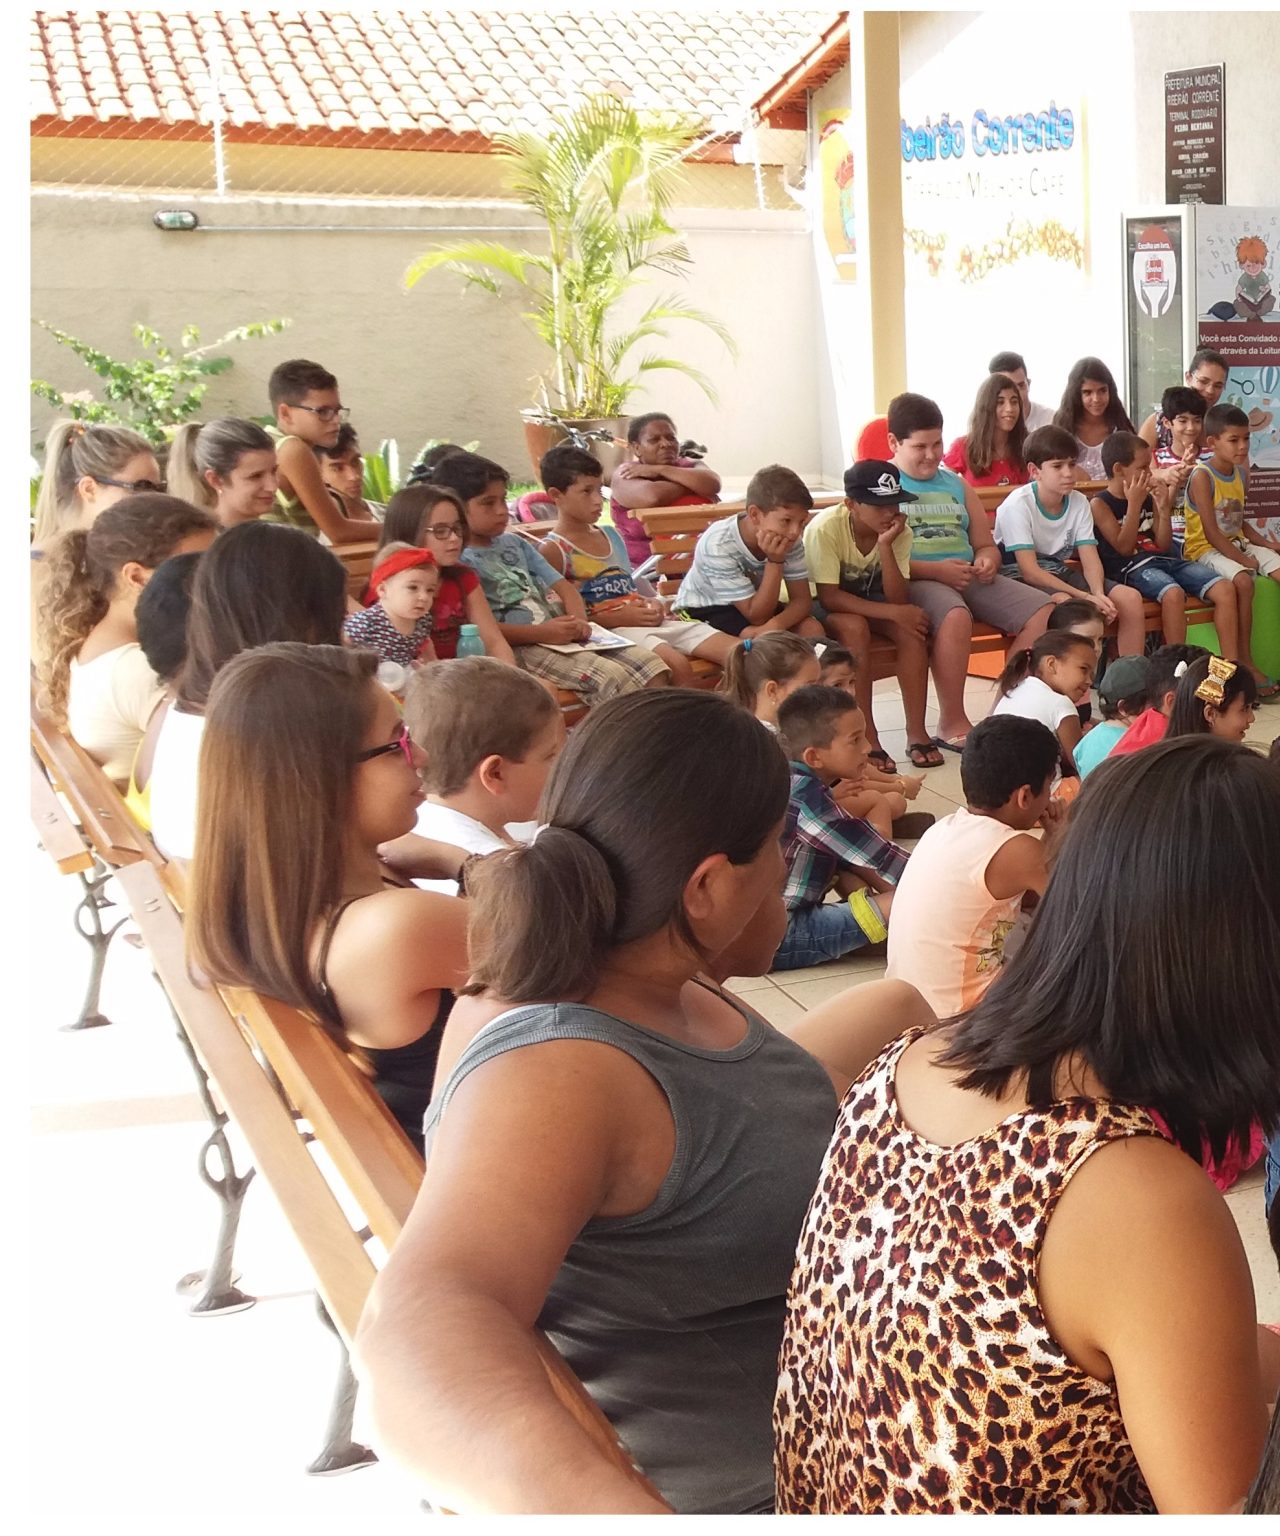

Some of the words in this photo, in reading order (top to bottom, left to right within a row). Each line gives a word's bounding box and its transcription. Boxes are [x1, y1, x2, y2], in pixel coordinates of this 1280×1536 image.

[1195, 73, 1221, 87] MUNICIPAL
[1191, 90, 1220, 104] CORRENTE
[1169, 111, 1190, 121] TERMINAL
[972, 99, 1075, 157] Corrente
[1200, 334, 1220, 343] Você
[1220, 334, 1238, 343] esta
[1238, 333, 1279, 343] Convidado
[1219, 346, 1247, 355] através
[1249, 346, 1259, 355] da
